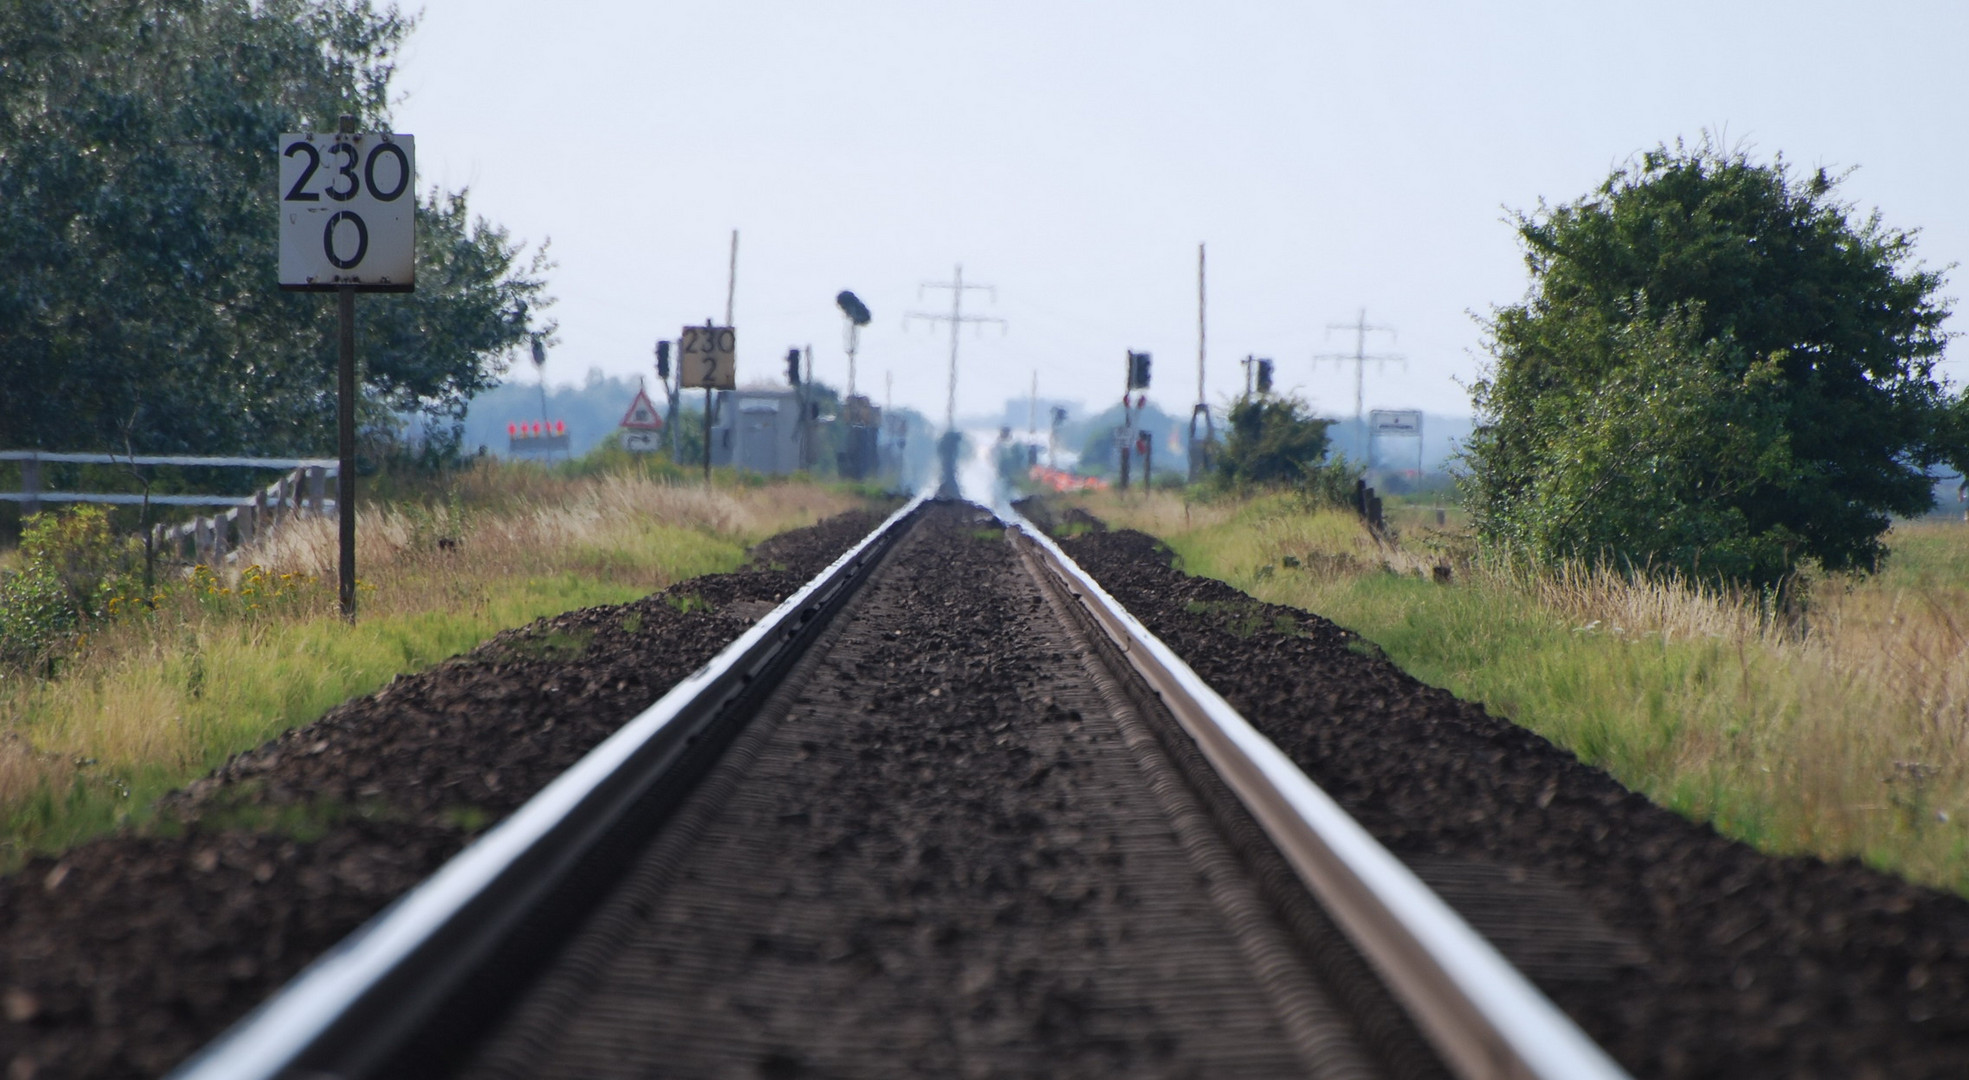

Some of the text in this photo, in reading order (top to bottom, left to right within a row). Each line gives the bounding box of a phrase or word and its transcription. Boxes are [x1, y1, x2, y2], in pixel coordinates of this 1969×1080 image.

[284, 142, 410, 202] 230
[323, 210, 369, 270] 0
[685, 328, 735, 354] 230
[702, 357, 718, 381] 2
